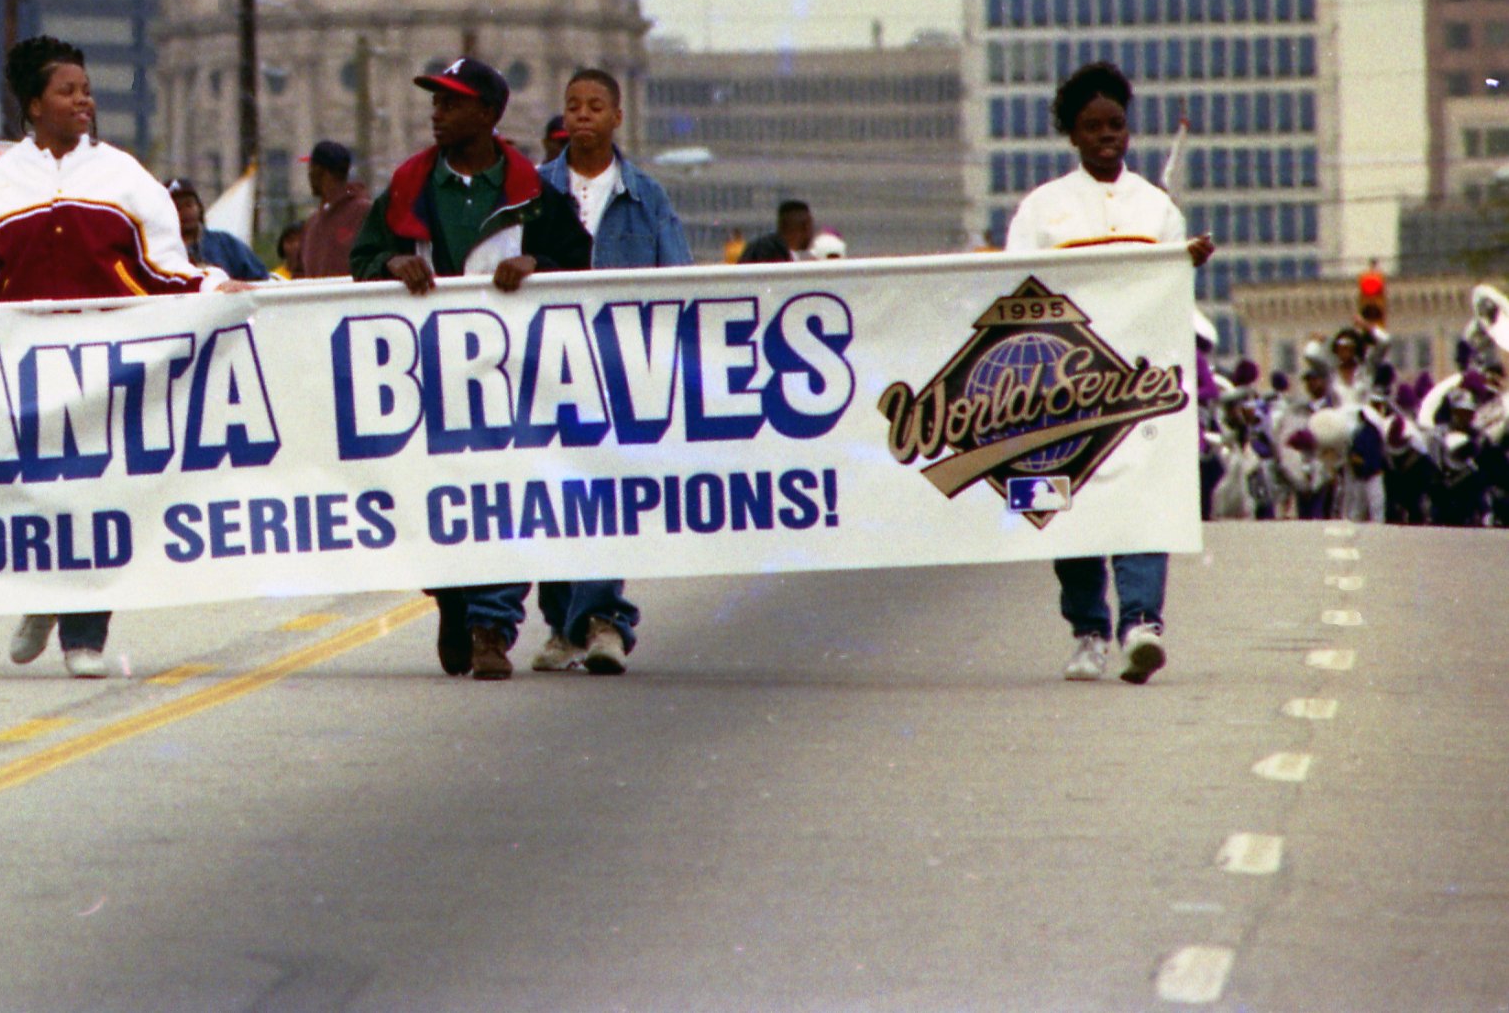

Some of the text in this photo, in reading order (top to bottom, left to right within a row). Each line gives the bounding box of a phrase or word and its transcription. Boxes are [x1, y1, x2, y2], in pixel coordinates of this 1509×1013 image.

[996, 300, 1066, 322] 1995
[330, 292, 856, 461] BRAVES
[876, 345, 1188, 465] World Series
[163, 490, 397, 564] SERIES
[425, 468, 840, 546] CHAMPIONS!
